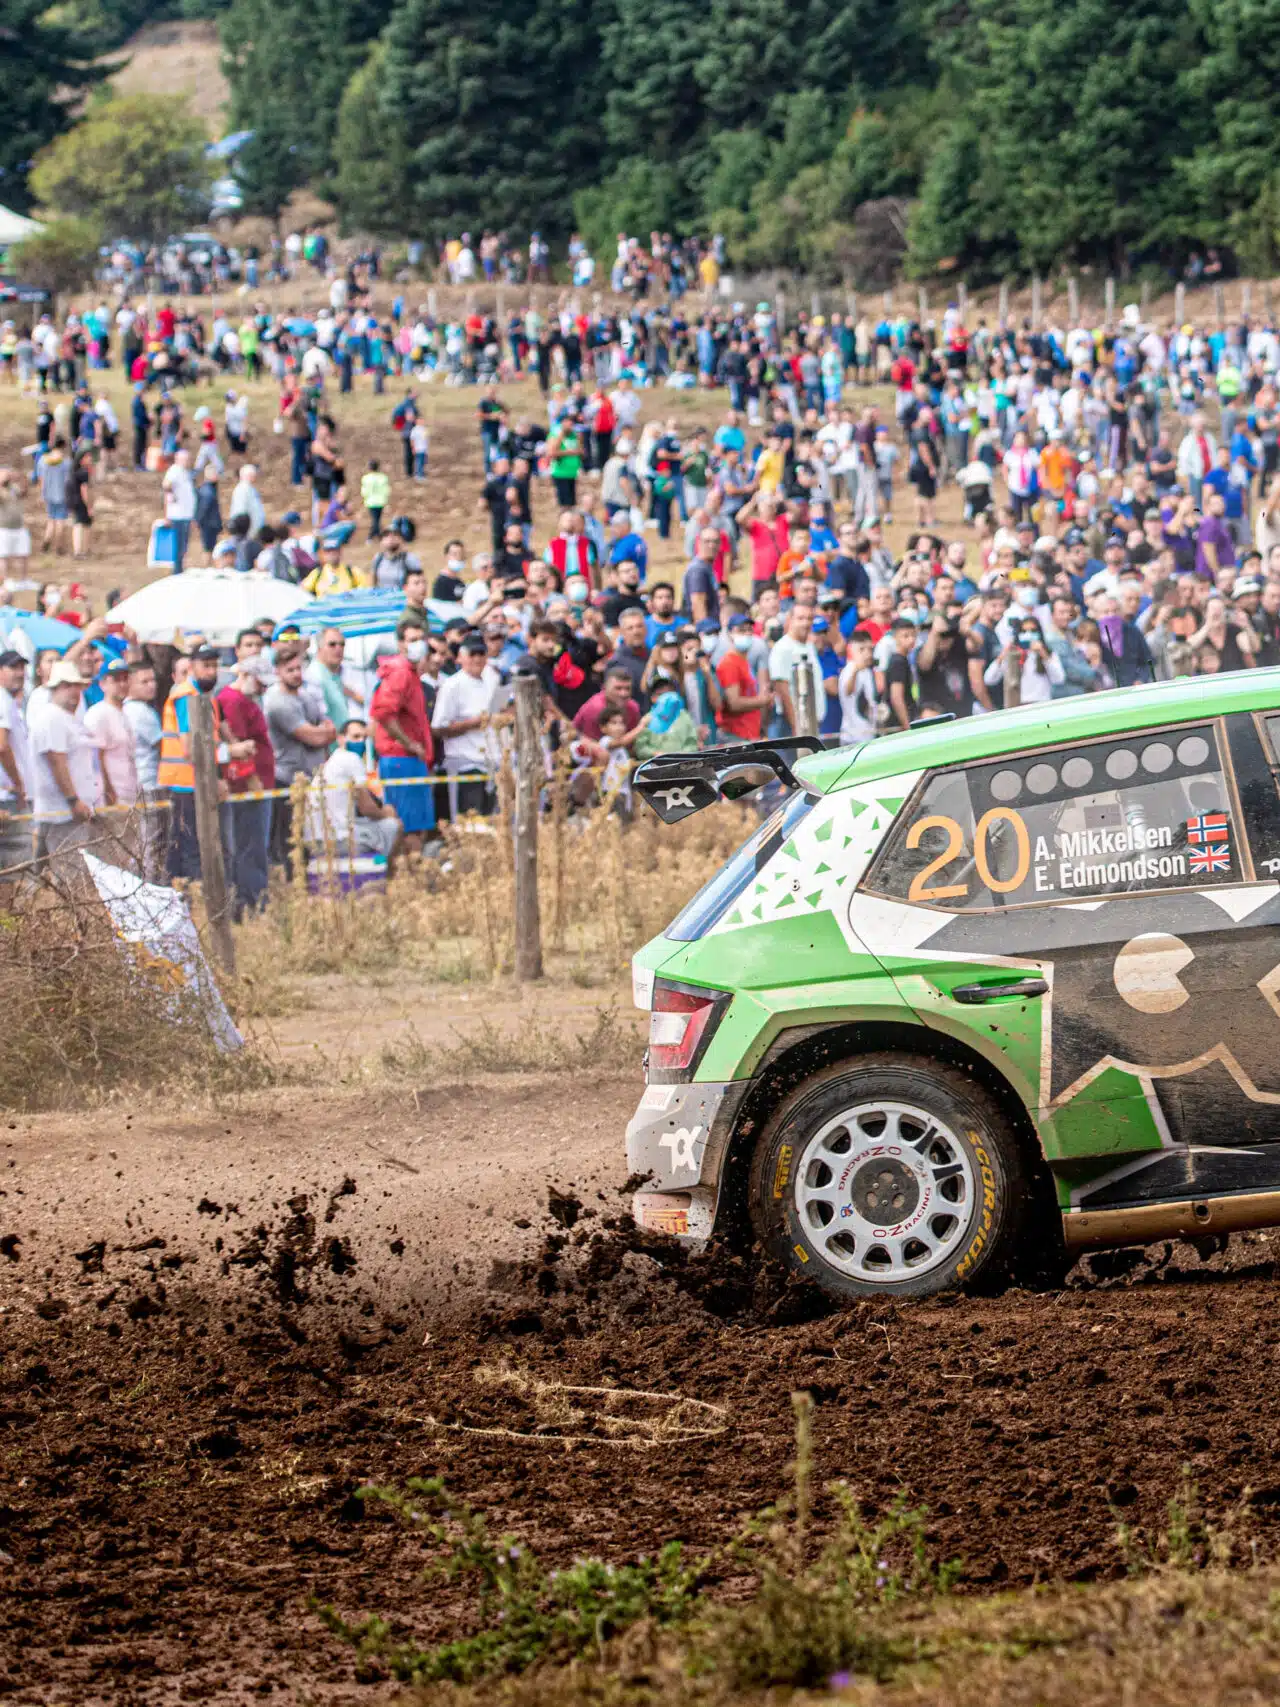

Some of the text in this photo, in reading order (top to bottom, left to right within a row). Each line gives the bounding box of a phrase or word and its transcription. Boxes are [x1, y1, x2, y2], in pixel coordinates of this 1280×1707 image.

[905, 807, 1030, 901] 20
[1034, 826, 1172, 862] A. Mikkelsen
[1035, 854, 1186, 892] E. Edmondson
[956, 1130, 996, 1280] SCORPION
